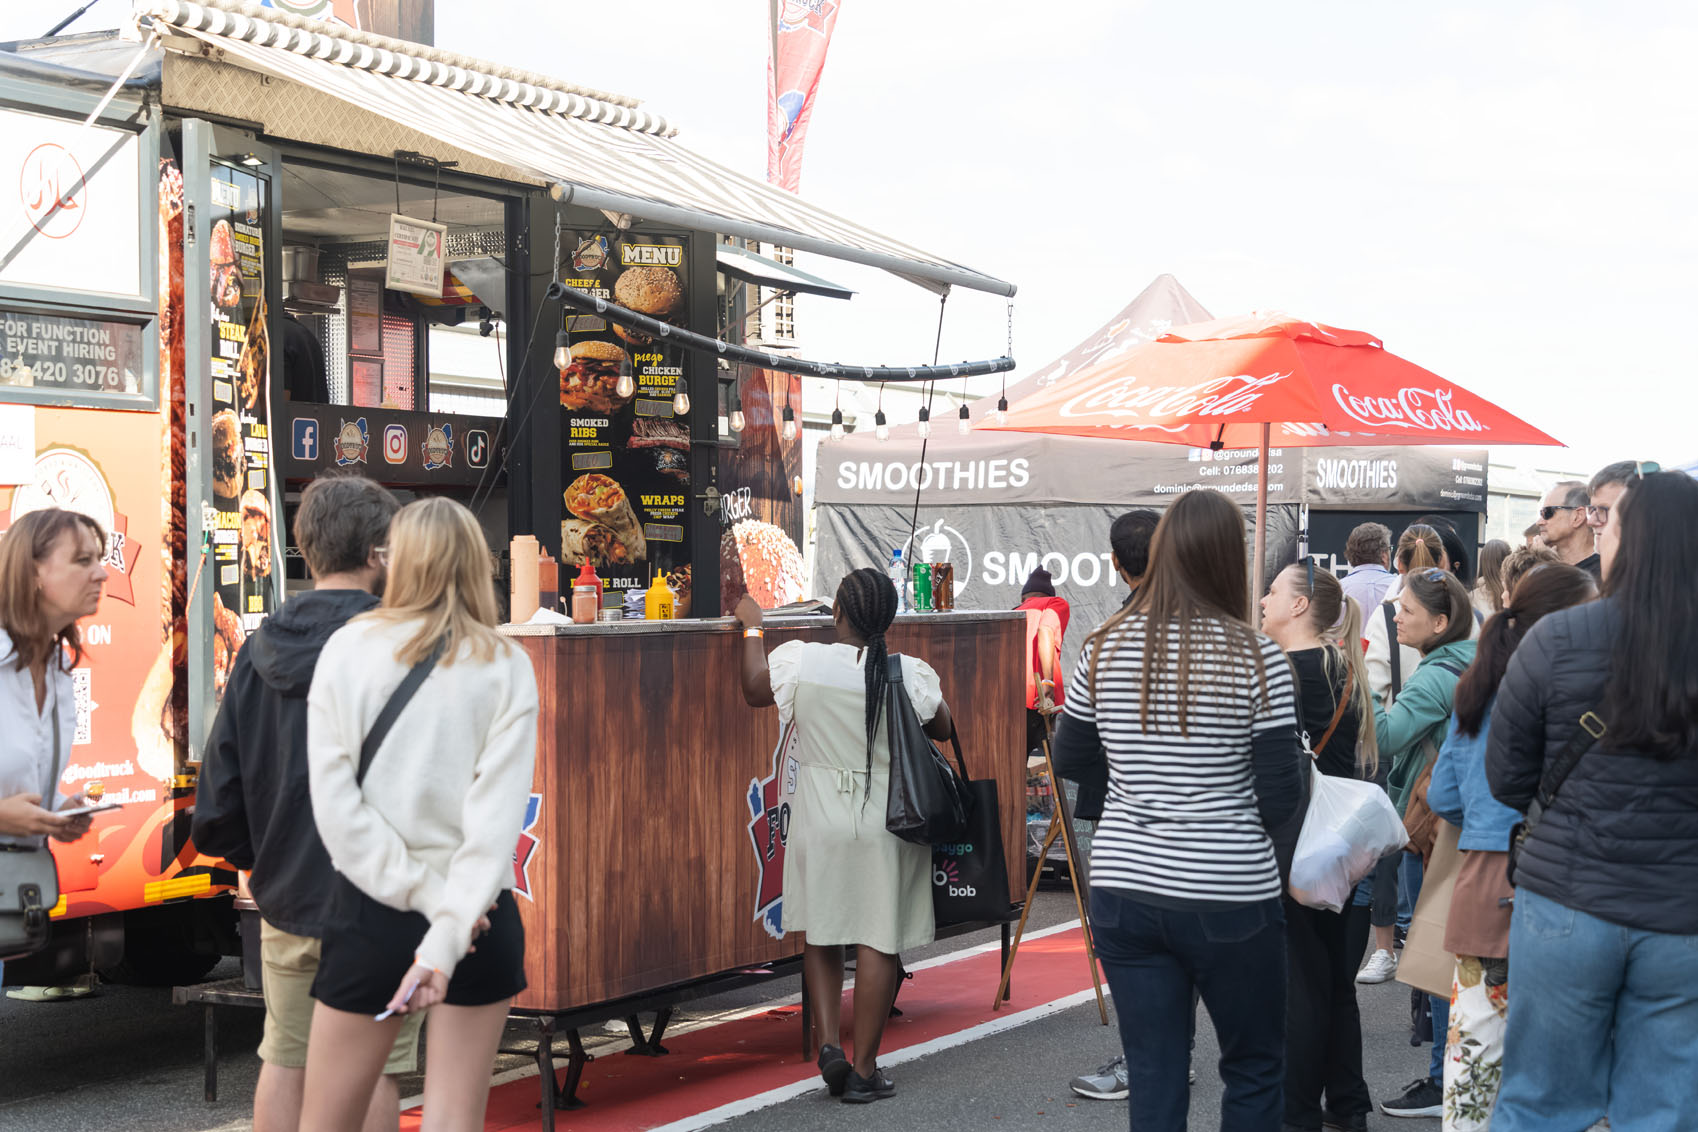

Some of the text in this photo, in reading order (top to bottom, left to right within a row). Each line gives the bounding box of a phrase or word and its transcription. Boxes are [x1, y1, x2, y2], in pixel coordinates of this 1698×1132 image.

[623, 245, 681, 266] MENU
[573, 288, 611, 299] RGER
[31, 322, 110, 345] FUNCTION
[7, 337, 116, 361] EVENT HIRING
[31, 360, 67, 382] 420
[72, 364, 119, 386] 3076
[642, 366, 683, 376] CHICKEN
[1332, 383, 1483, 432] Coca-Cola
[570, 418, 609, 427] SMOKED
[570, 427, 598, 438] RIBS
[1214, 448, 1282, 461] @groundsa
[837, 458, 1030, 491] SMOOTHIES
[1200, 463, 1284, 476] Cell: 076838202
[1316, 458, 1398, 489] SMOOTHIES
[640, 495, 685, 506] WRAPS
[612, 577, 641, 588] ROLL
[88, 625, 112, 645] ON
[949, 884, 977, 897] bob
